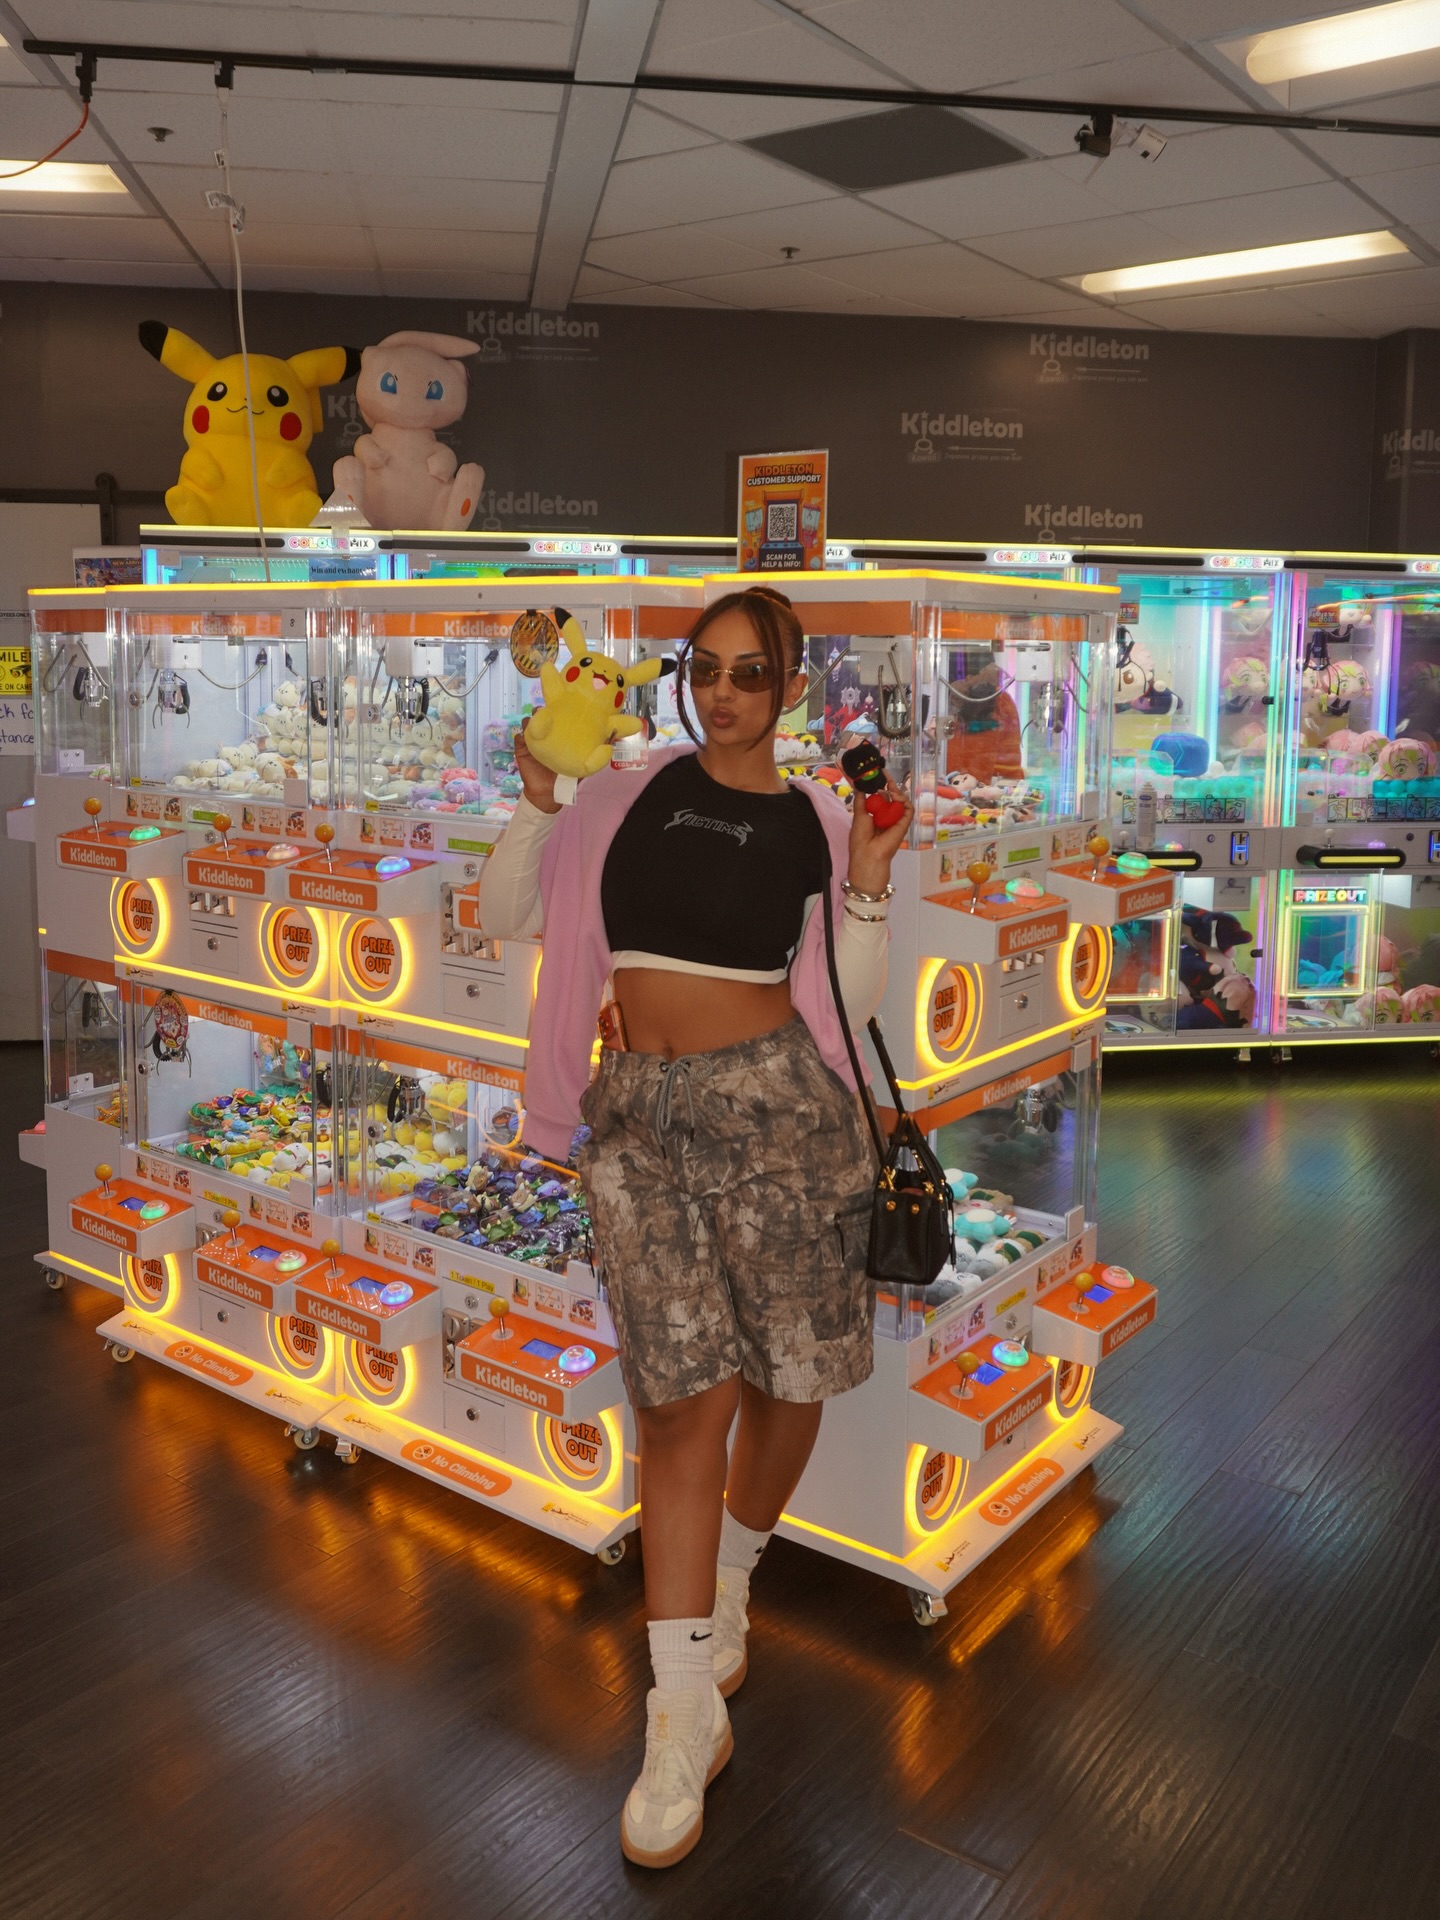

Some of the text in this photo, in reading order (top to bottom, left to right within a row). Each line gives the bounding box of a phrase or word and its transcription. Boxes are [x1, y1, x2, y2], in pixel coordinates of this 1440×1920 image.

[466, 309, 599, 338] Kiddleton
[1029, 332, 1149, 360] Kiddleton
[901, 411, 1023, 438] Kiddleton
[747, 475, 821, 485] CUSTOMER SUPPORT
[755, 464, 814, 477] KIDDLETON
[1025, 503, 1143, 528] Kiddleton
[288, 537, 369, 549] COLOUR MIX
[535, 542, 612, 553] COLOUR MIX
[761, 560, 778, 568] HELP
[766, 553, 783, 561] SCAN
[996, 552, 1067, 562] COLOUR MIX
[1212, 556, 1279, 568] COLOUR MIX
[324, 566, 337, 574] and
[191, 620, 246, 635] Kiddleton
[444, 619, 513, 637] Kiddleto
[995, 621, 1044, 638] Kiddleton
[664, 808, 754, 847] VICTIMS
[70, 847, 117, 867] Kiddleton
[199, 867, 253, 890] Kiddleton
[301, 881, 363, 906] Kiddleton
[1126, 891, 1165, 913] Kiddleton
[1294, 889, 1367, 903] PRIZE OUT
[133, 914, 153, 932] OUT
[1009, 924, 1057, 950] Kiddleton
[286, 944, 310, 962] OUT
[365, 956, 391, 974] OUT
[935, 985, 957, 1011] RIZE
[199, 1004, 253, 1030] Kiddleton
[933, 1008, 955, 1033] OUT
[447, 1060, 519, 1090] Kiddleton
[982, 1075, 1032, 1106] Kiddleton
[81, 1216, 128, 1247] Kiddleton
[143, 1272, 163, 1292] OUT
[208, 1267, 262, 1302] Kiddleton
[481, 1282, 494, 1293] Play
[307, 1299, 368, 1337] Kiddleton
[1110, 1311, 1148, 1349] Kiddleton
[293, 1335, 317, 1356] OUT
[189, 1353, 240, 1381] No Climbing
[369, 1360, 394, 1382] OUT
[475, 1364, 548, 1407] Kiddleton
[995, 1393, 1042, 1440] Kiddleton
[566, 1439, 598, 1464] OUT
[431, 1455, 497, 1490] No Climbing
[921, 1474, 944, 1504] OUT
[1005, 1466, 1055, 1506] No Climbing
